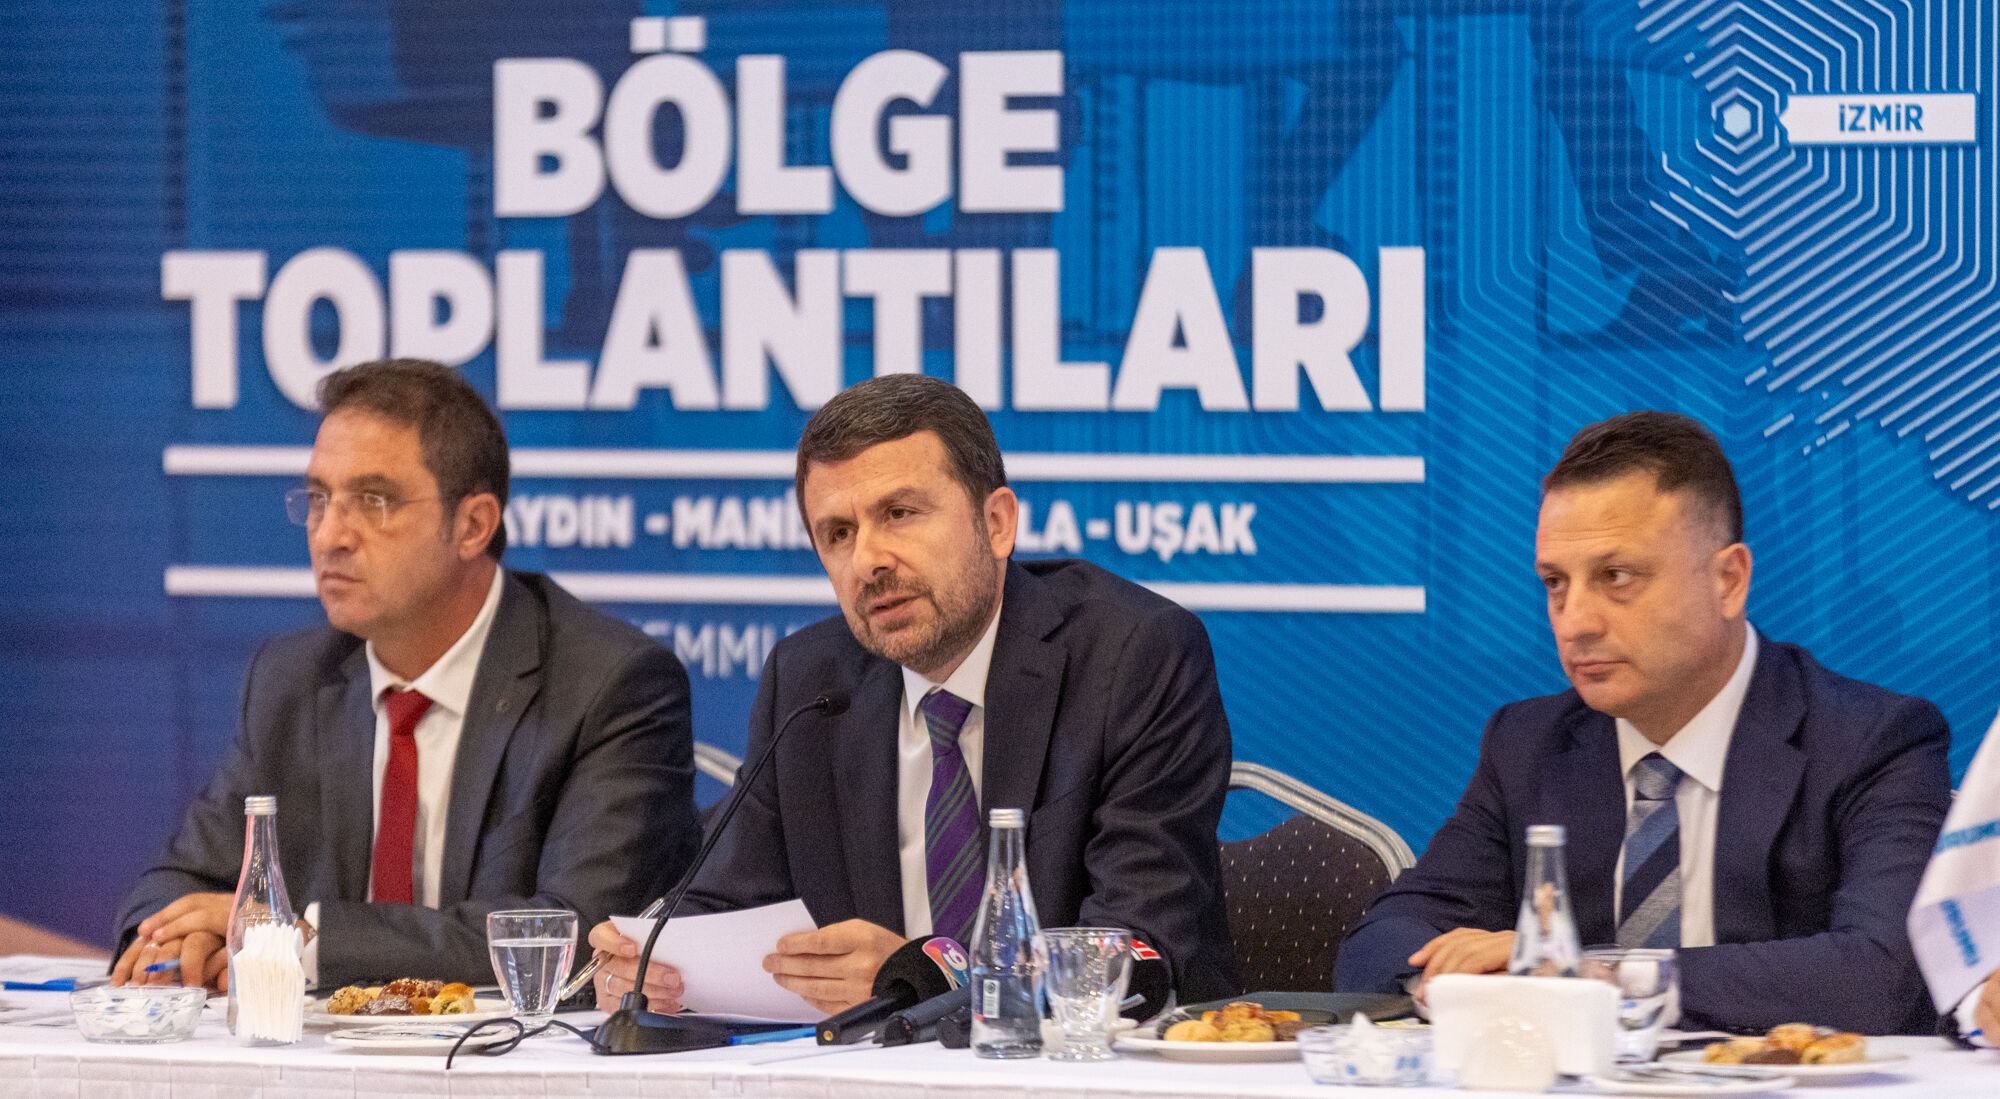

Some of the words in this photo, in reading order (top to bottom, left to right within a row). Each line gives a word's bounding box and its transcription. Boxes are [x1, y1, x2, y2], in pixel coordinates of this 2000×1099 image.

[494, 17, 1064, 218] BÖLGE
[1839, 103, 1923, 132] İZMİR
[162, 247, 1426, 412] TOPLANTILARI
[673, 487, 815, 549] MANİ
[1115, 502, 1257, 562] UŞAK
